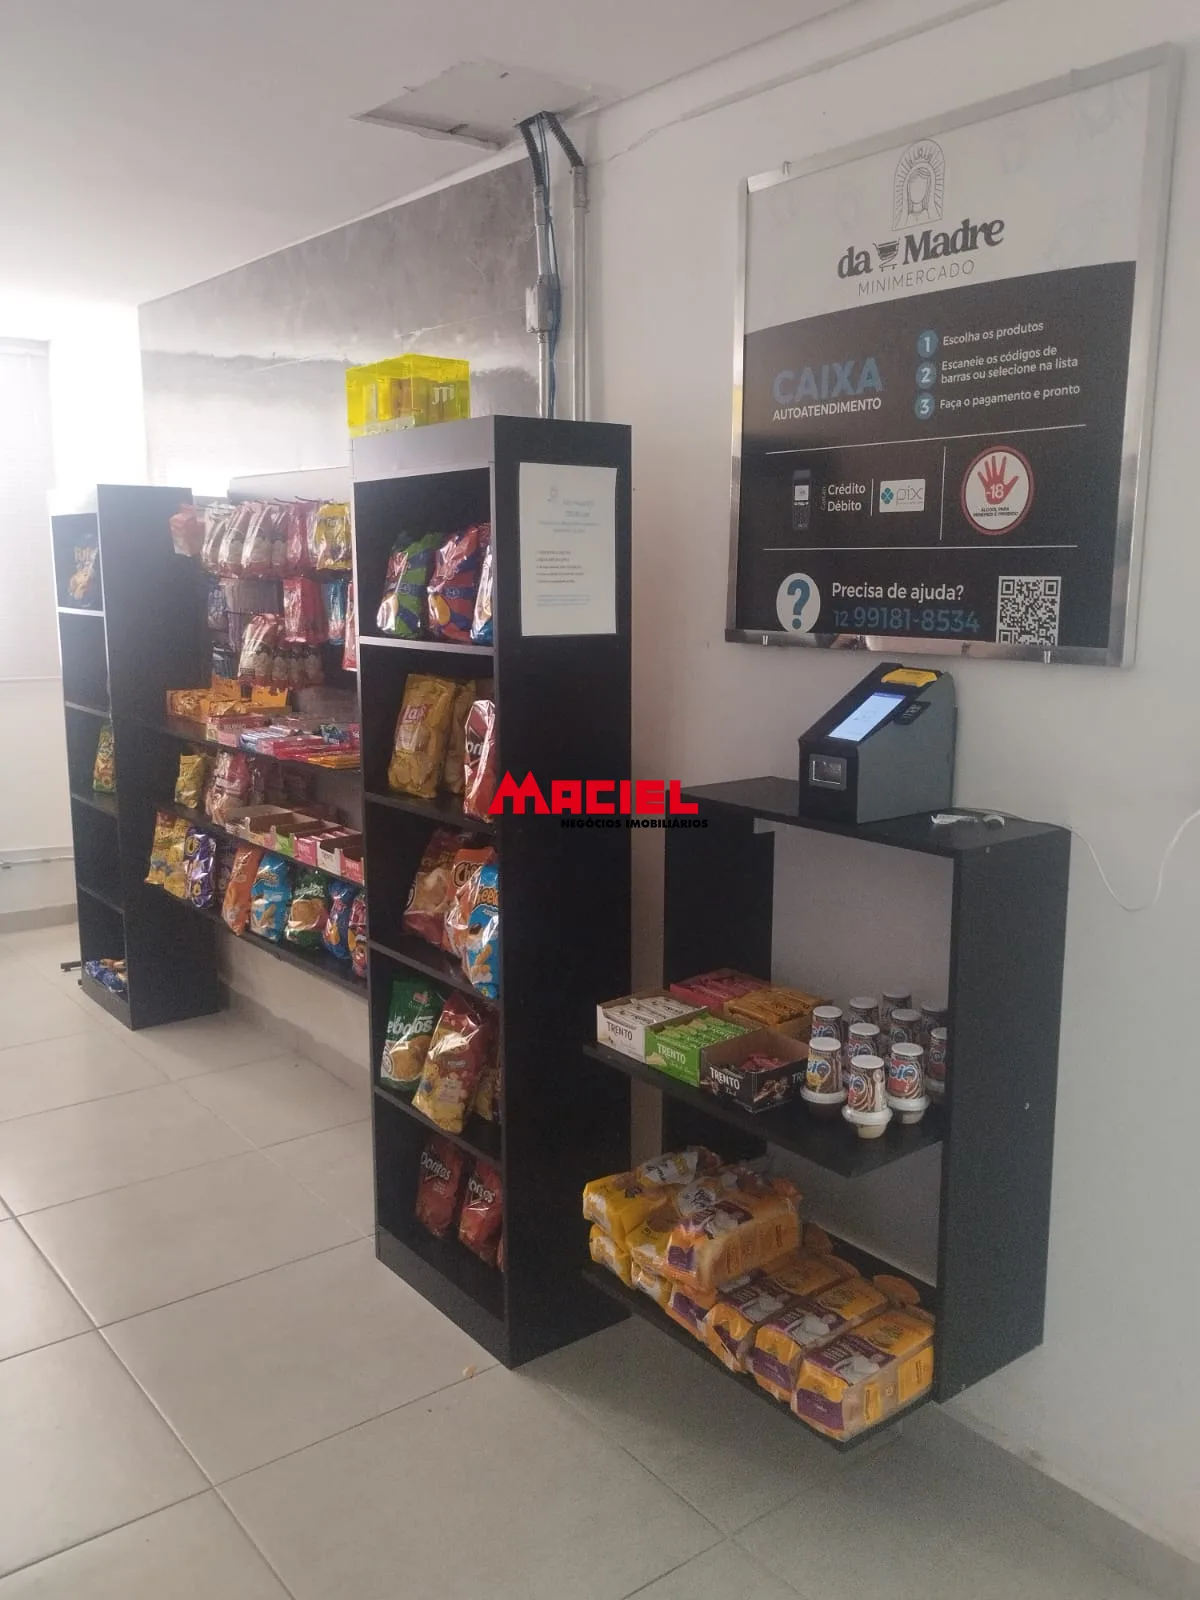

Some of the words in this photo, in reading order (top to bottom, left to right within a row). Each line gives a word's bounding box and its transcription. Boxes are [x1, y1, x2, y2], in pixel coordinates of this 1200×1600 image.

[837, 246, 873, 279] da
[902, 218, 1005, 265] Madre
[858, 259, 975, 297] MINIMERCADO
[943, 331, 980, 346] Escolha
[982, 330, 994, 340] os
[996, 322, 1044, 340] produtos
[941, 370, 971, 384] barras
[973, 370, 986, 380] ou
[988, 362, 1037, 377] selecione
[1039, 361, 1052, 371] na
[1055, 357, 1078, 369] lista
[942, 357, 985, 371] Escaneie
[986, 355, 998, 364] os
[1000, 347, 1040, 363] códigos
[1043, 346, 1057, 356] de
[773, 357, 883, 404] CAIXA
[772, 398, 882, 421] AUTOATENDIMENTO
[940, 398, 961, 411] Faça
[964, 398, 970, 406] o
[972, 391, 1031, 407] pagamento
[1034, 389, 1040, 398] e
[1043, 384, 1081, 399] pronto
[828, 480, 865, 495] Crédito
[896, 484, 924, 506] pix
[827, 500, 861, 512] Débito
[832, 582, 883, 598] Precisa
[887, 582, 906, 599] de
[910, 584, 964, 603] ajuda?
[834, 609, 849, 628] 12
[853, 606, 980, 633] 99181-8534
[607, 1021, 633, 1041] TRENTO
[657, 1043, 686, 1064] TRENTO
[709, 1066, 740, 1090] TRENTO
